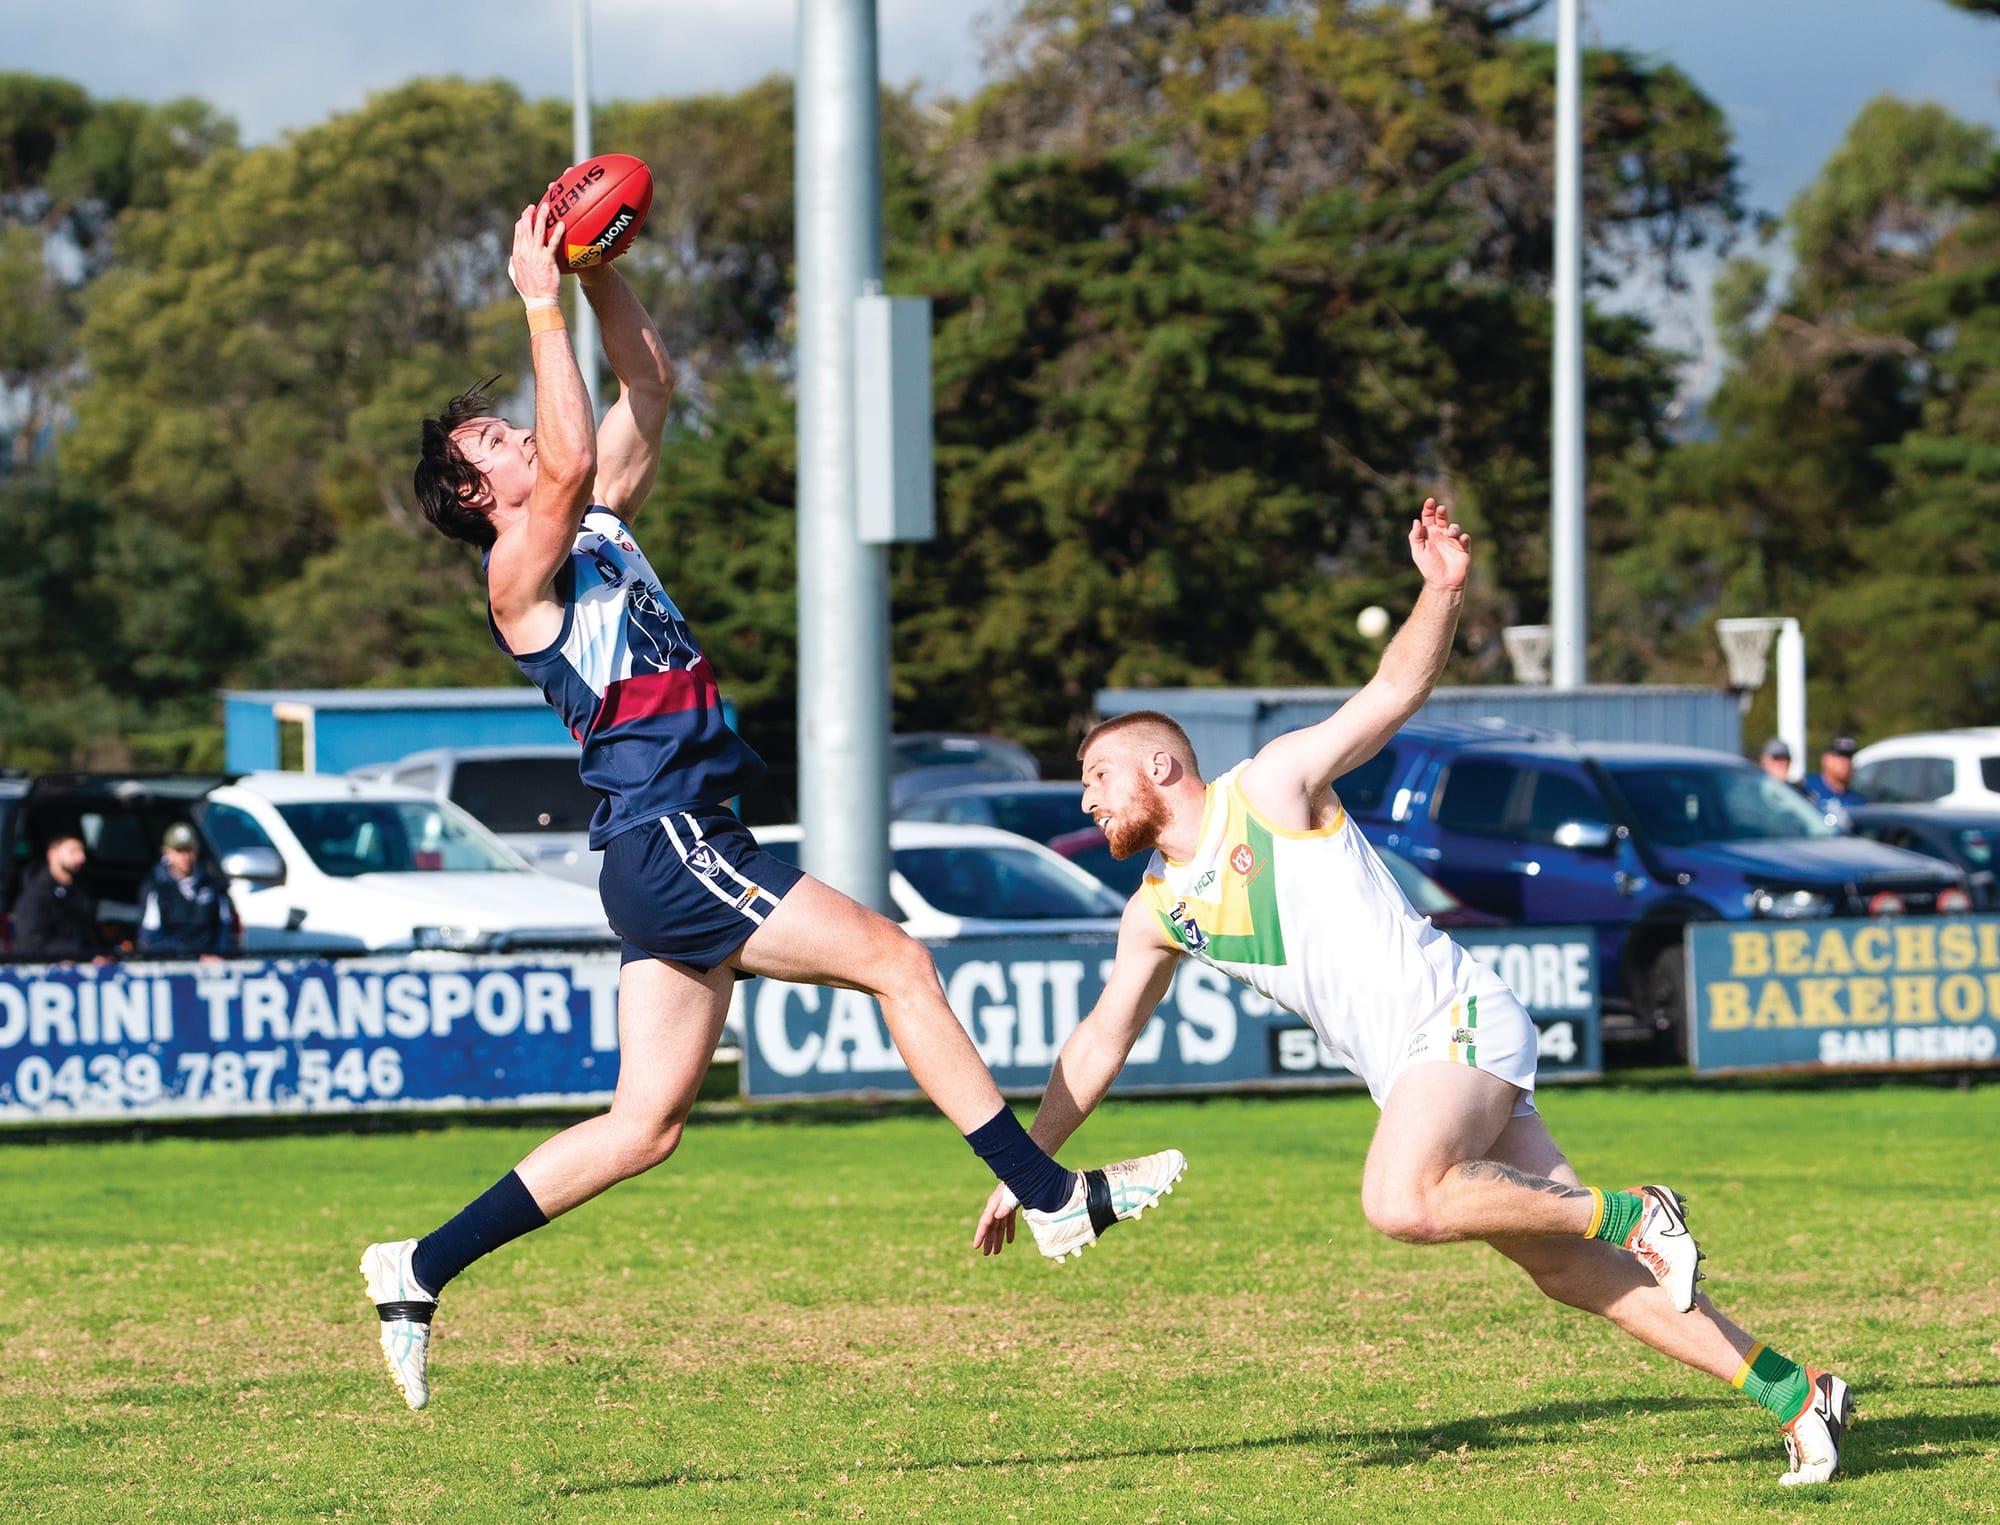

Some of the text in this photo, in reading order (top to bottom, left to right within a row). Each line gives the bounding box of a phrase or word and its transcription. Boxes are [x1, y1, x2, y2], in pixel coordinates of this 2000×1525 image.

[546, 165, 605, 229] SHERR
[1469, 943, 1593, 1009] TORE
[1731, 922, 2000, 977] BEACHSI
[197, 968, 619, 1050] TRANSPORT
[754, 958, 1238, 1077] CAGIL'S
[15, 1046, 404, 1104] 0439 787 546
[1819, 1025, 1997, 1065] SAN REMO
